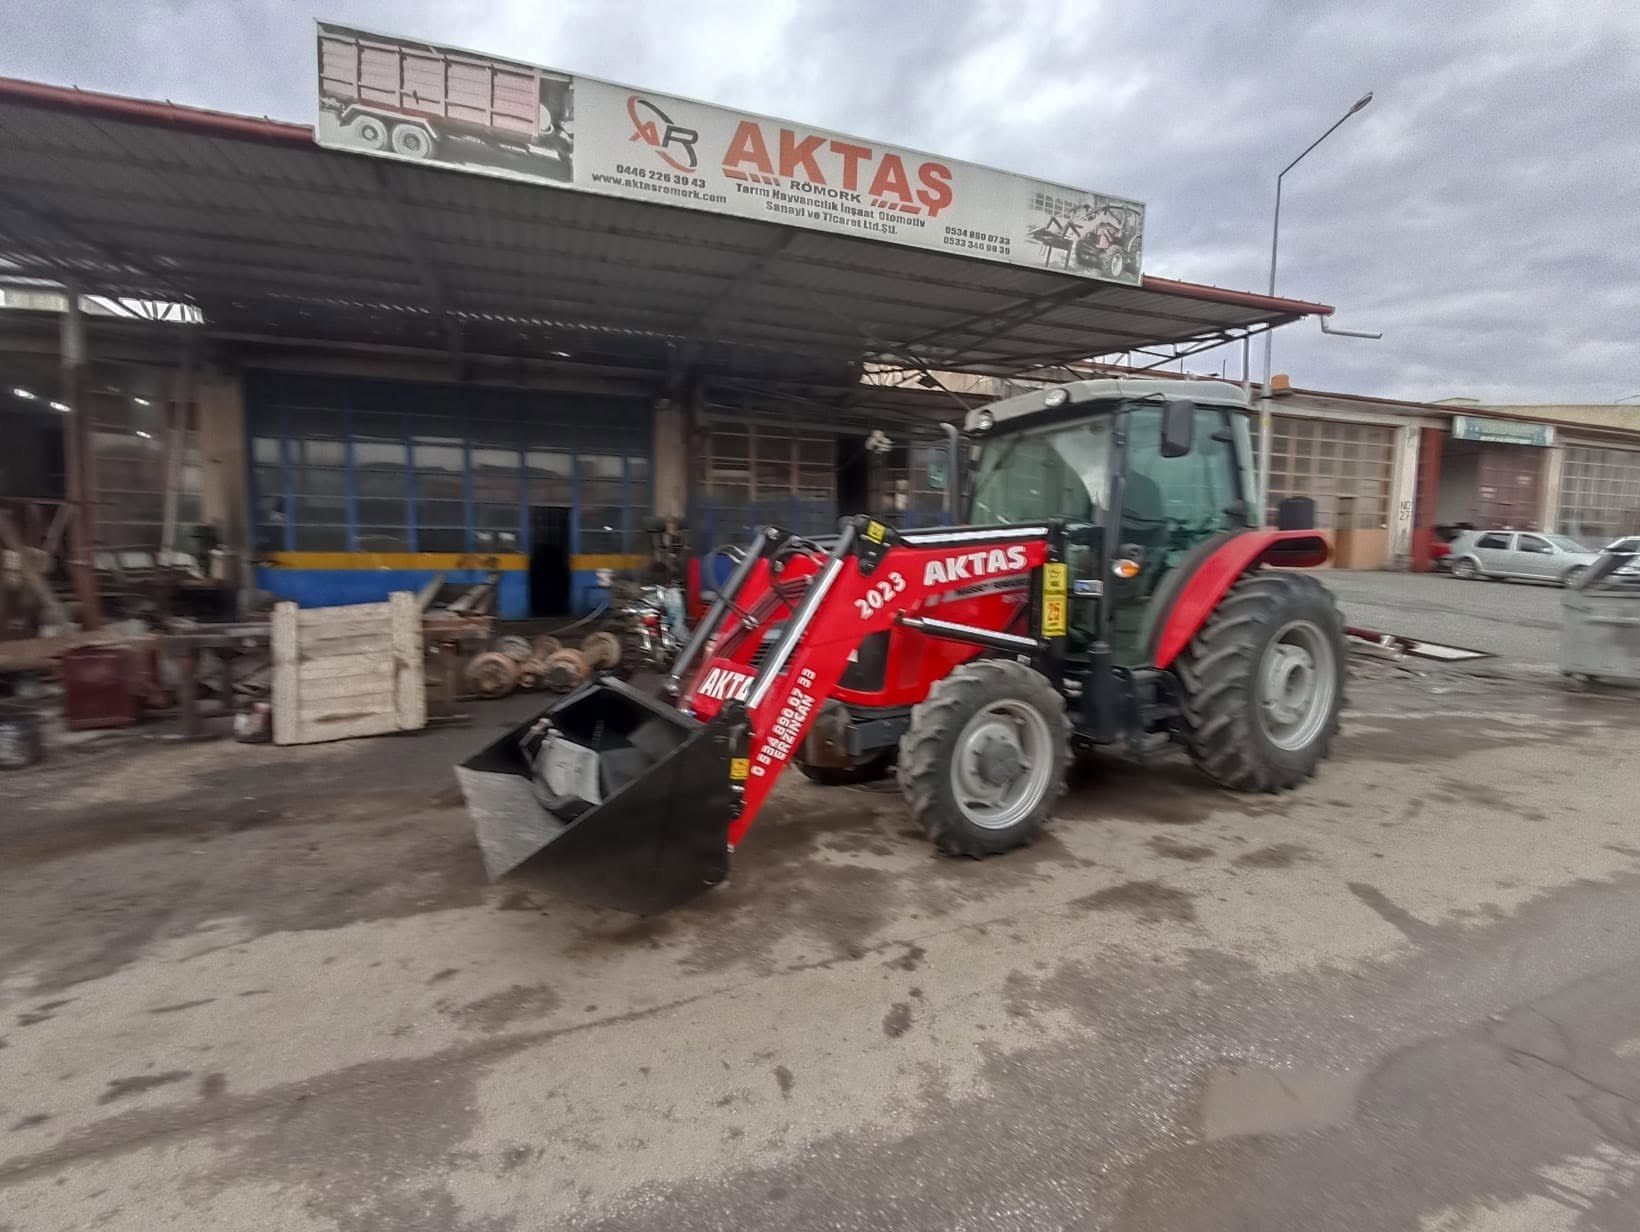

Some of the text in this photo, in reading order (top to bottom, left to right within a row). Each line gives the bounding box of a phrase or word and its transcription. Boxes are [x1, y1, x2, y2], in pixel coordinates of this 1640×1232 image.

[616, 164, 646, 178] 0446
[648, 170, 671, 183] 226
[691, 177, 706, 189] 43
[722, 120, 954, 218] AKTAŞ
[592, 172, 727, 204] www.aktasromork.com
[790, 180, 862, 204] RÖMORK
[807, 210, 821, 220] ve
[945, 226, 968, 237] 0534
[923, 545, 1027, 586] AKTAS
[854, 571, 907, 620] 2023
[697, 666, 755, 701] AKTA
[750, 667, 817, 777] 0 534 890 07 33
